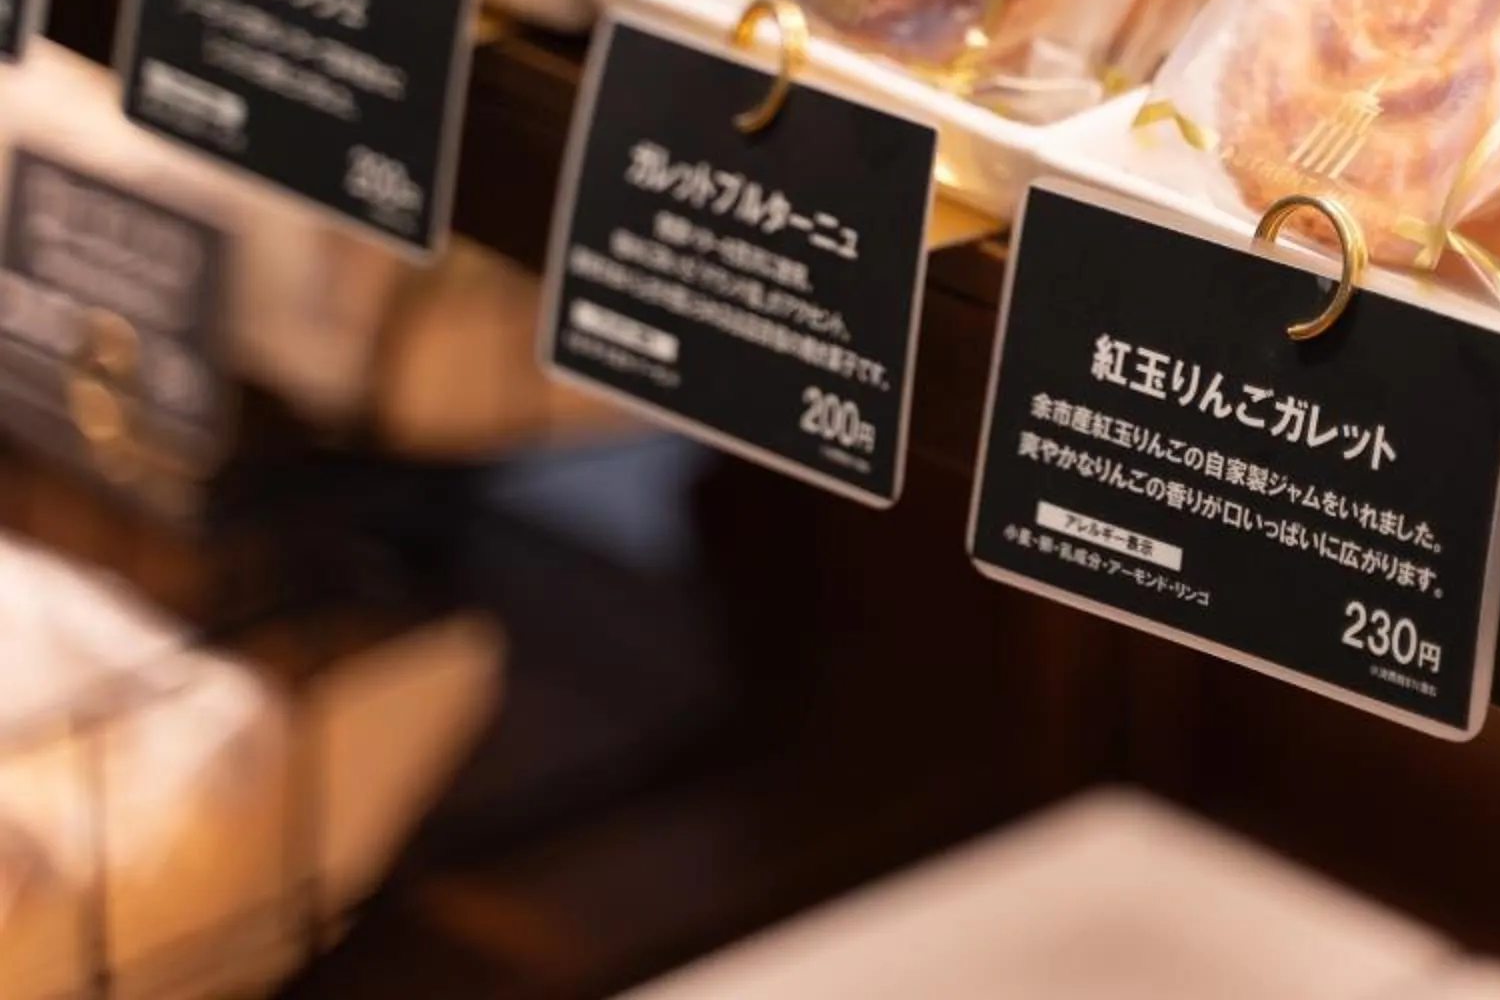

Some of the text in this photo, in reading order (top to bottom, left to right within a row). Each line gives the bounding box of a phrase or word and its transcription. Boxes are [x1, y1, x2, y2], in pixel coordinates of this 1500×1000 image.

[799, 385, 875, 453] 200円
[1091, 333, 1395, 470] 紅玉りんごガレット
[1018, 431, 1441, 598] 爽やかなりんごの香りが口いっぱいに広がります。
[1031, 392, 1440, 552] 余市産紅玉りんごの自家製ジャムをいれました。
[1065, 514, 1152, 556] アレルギー表示
[1341, 600, 1440, 672] 230円
